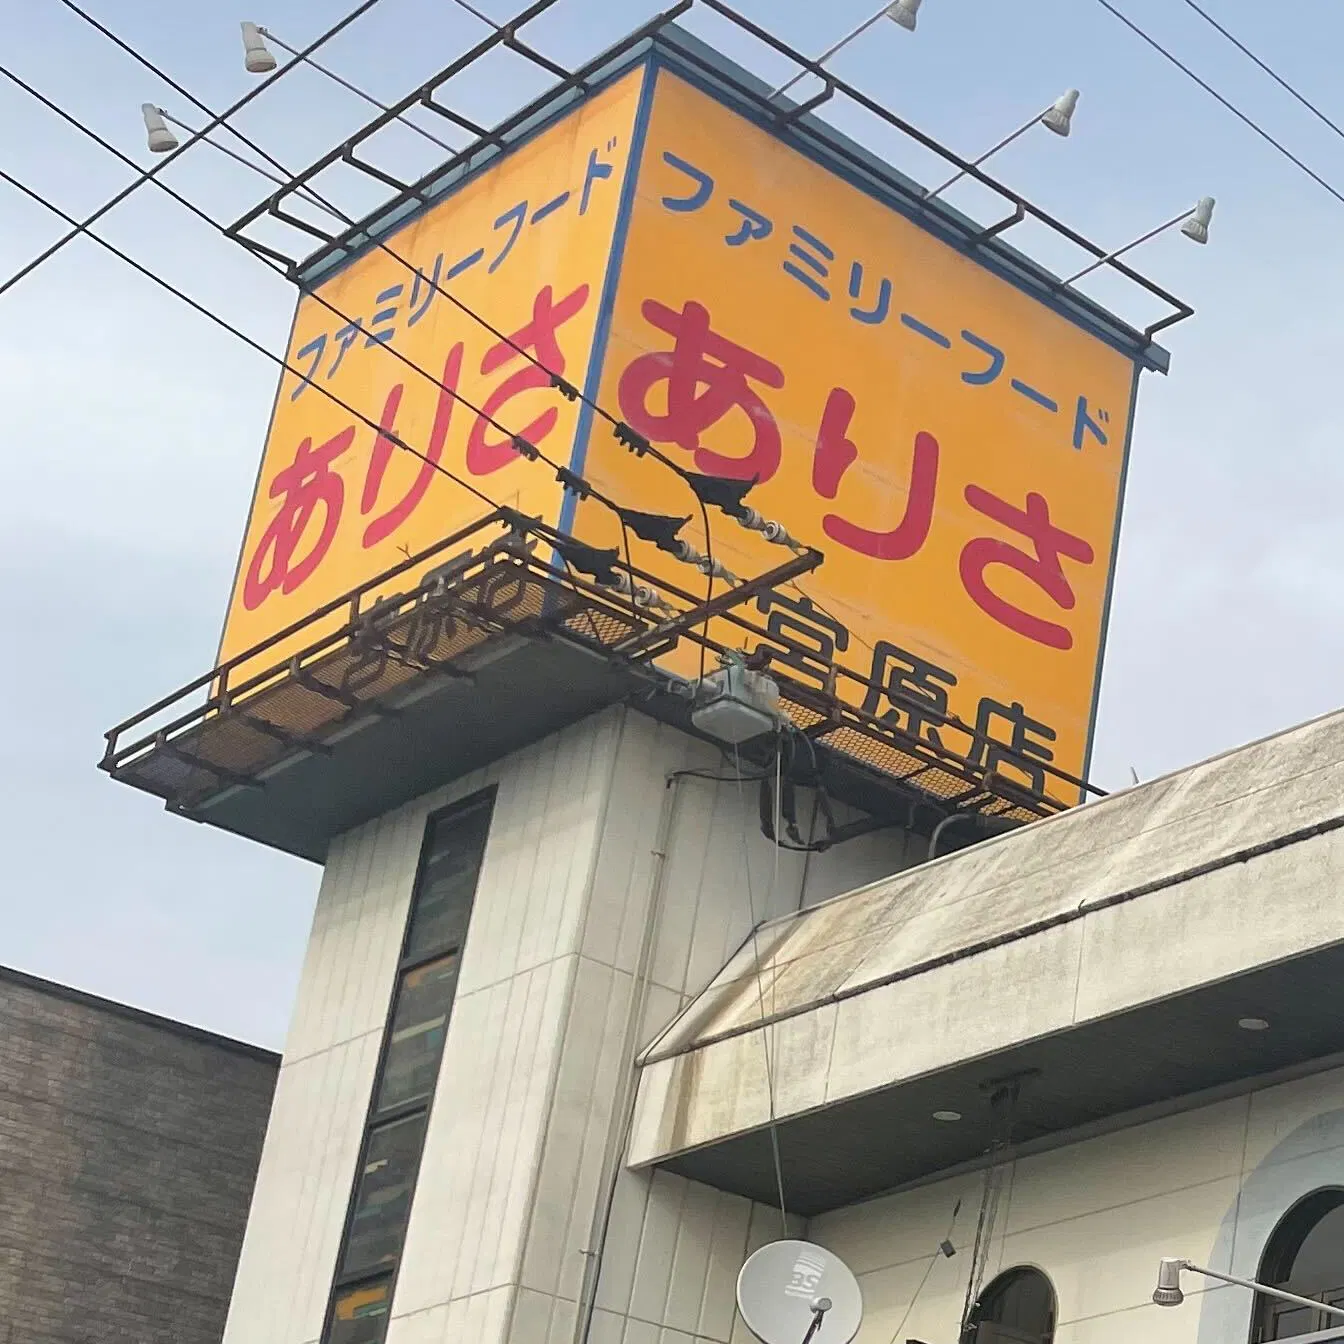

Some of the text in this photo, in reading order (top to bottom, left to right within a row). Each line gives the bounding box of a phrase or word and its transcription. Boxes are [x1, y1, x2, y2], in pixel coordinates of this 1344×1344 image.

[291, 136, 617, 402] ファミリーフード
[662, 149, 1112, 452] ファミリーフード
[243, 284, 590, 611] ありさ
[617, 299, 1094, 651] ありさ
[755, 590, 1057, 797] 宮原店
